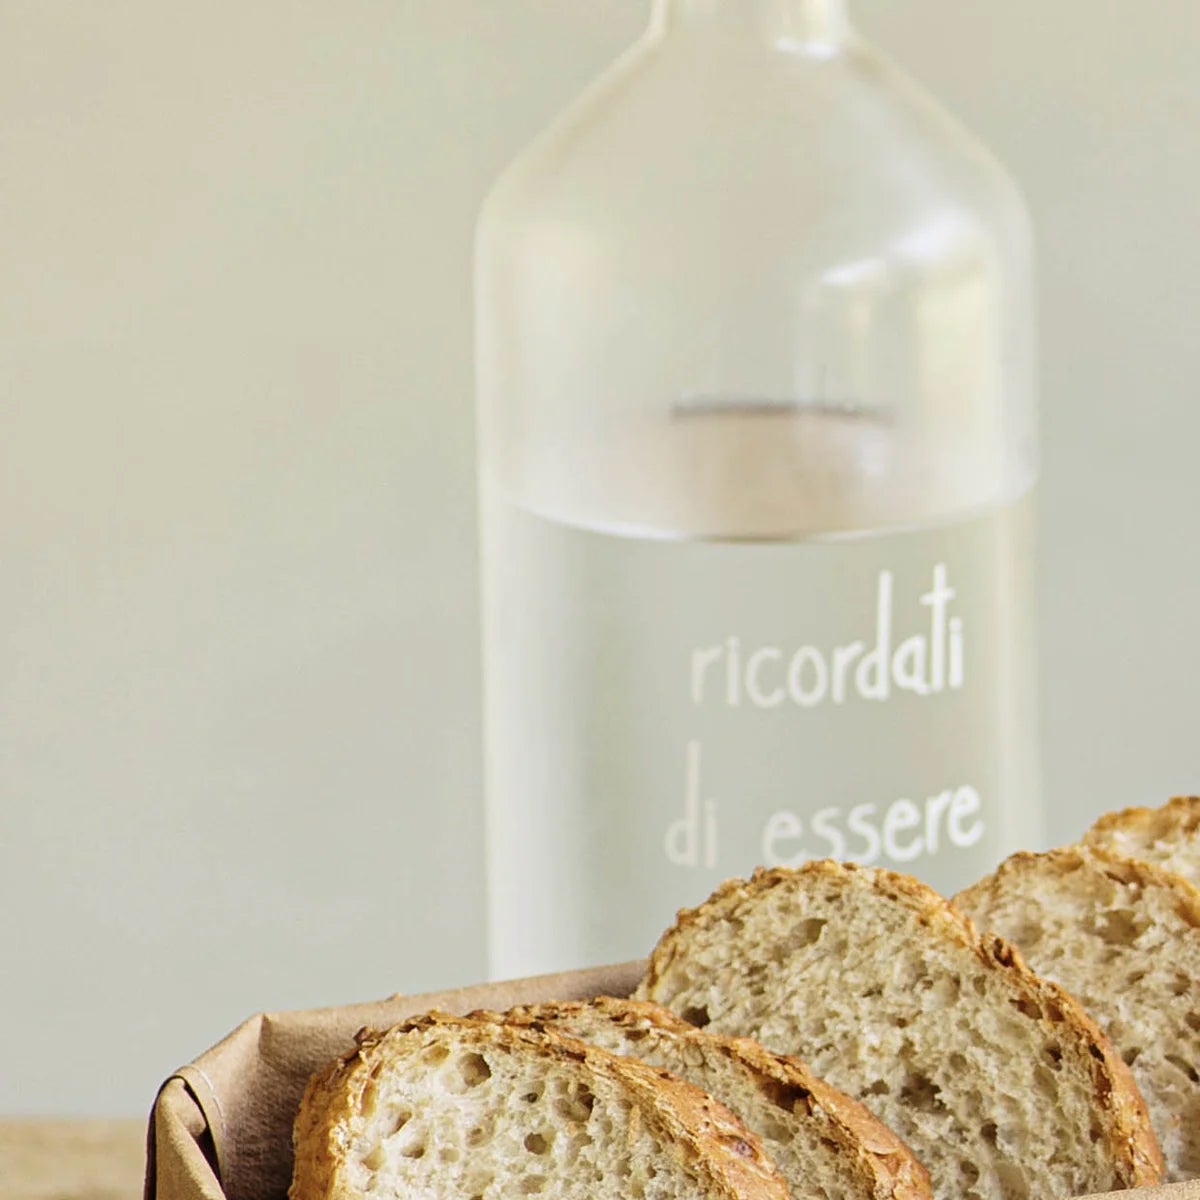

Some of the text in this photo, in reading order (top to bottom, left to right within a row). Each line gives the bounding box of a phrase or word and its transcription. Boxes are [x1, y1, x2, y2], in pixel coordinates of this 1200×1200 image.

[690, 561, 965, 707] ricordati
[664, 739, 985, 869] di essere
